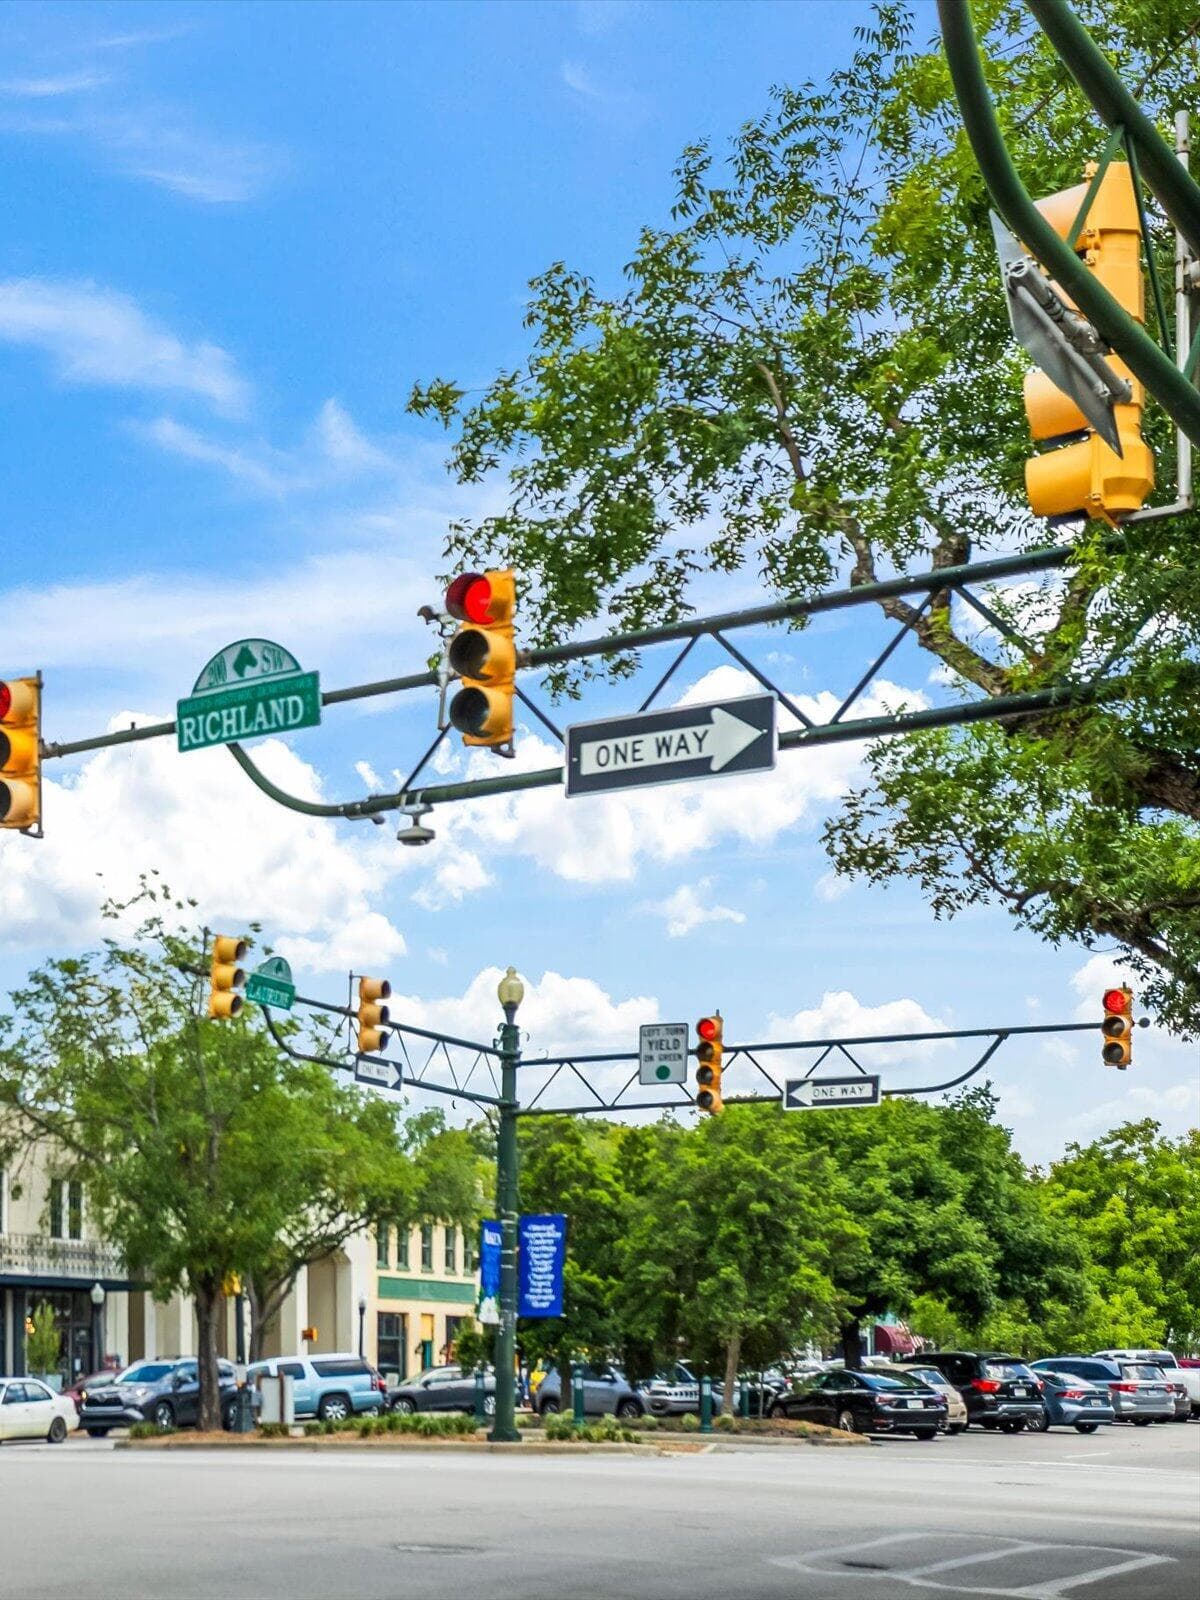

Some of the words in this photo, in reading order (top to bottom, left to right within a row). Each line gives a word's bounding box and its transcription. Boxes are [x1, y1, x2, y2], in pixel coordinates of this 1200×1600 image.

[182, 695, 304, 746] RICHLAND
[596, 740, 644, 767] ONE
[655, 729, 709, 758] WAY
[648, 1038, 681, 1050] YIELD
[658, 1053, 682, 1062] GREEN
[813, 1088, 835, 1097] ONE
[841, 1086, 865, 1096] WAY
